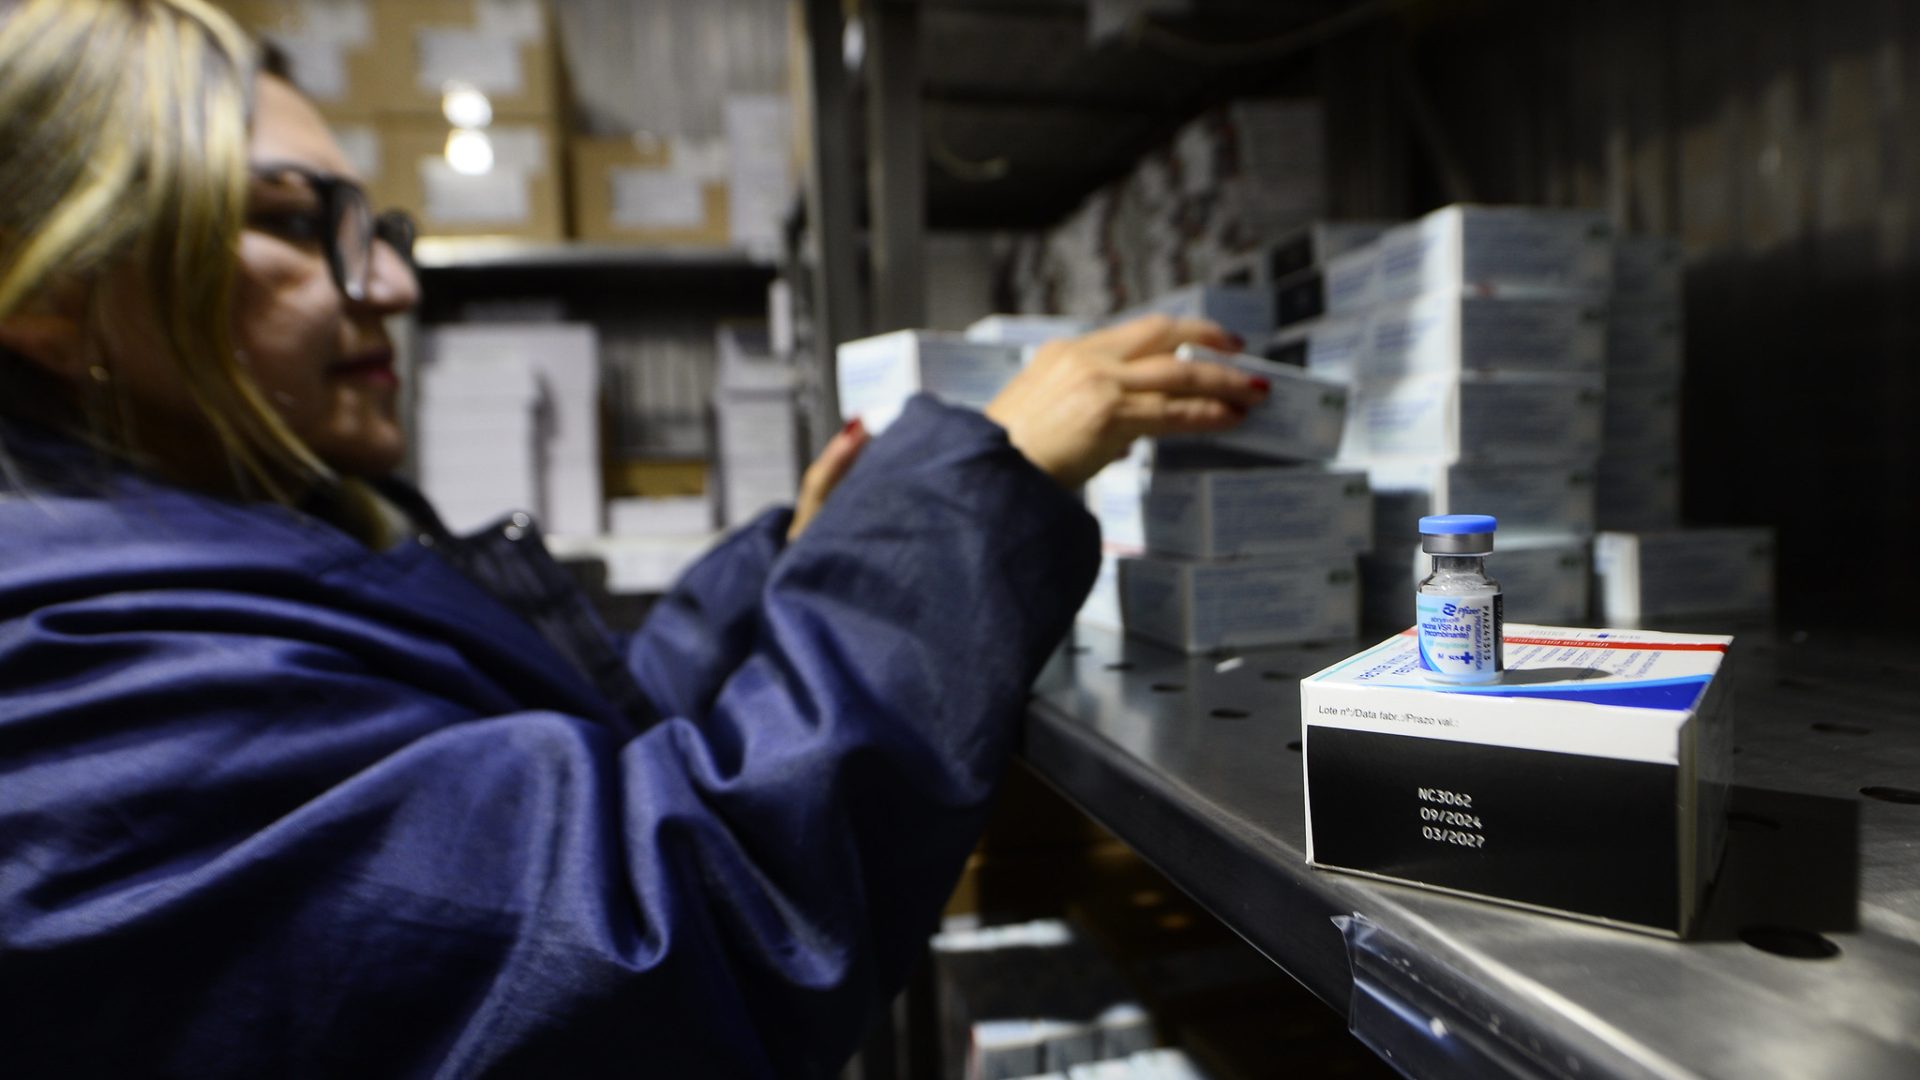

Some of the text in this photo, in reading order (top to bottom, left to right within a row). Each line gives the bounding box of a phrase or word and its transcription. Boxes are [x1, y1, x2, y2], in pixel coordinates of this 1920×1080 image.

[1466, 624, 1472, 632] B
[1318, 705, 1338, 715] Lote
[1418, 787, 1472, 808] NC3062
[1420, 806, 1482, 829] 09/2024
[1422, 825, 1485, 848] 03/2027
